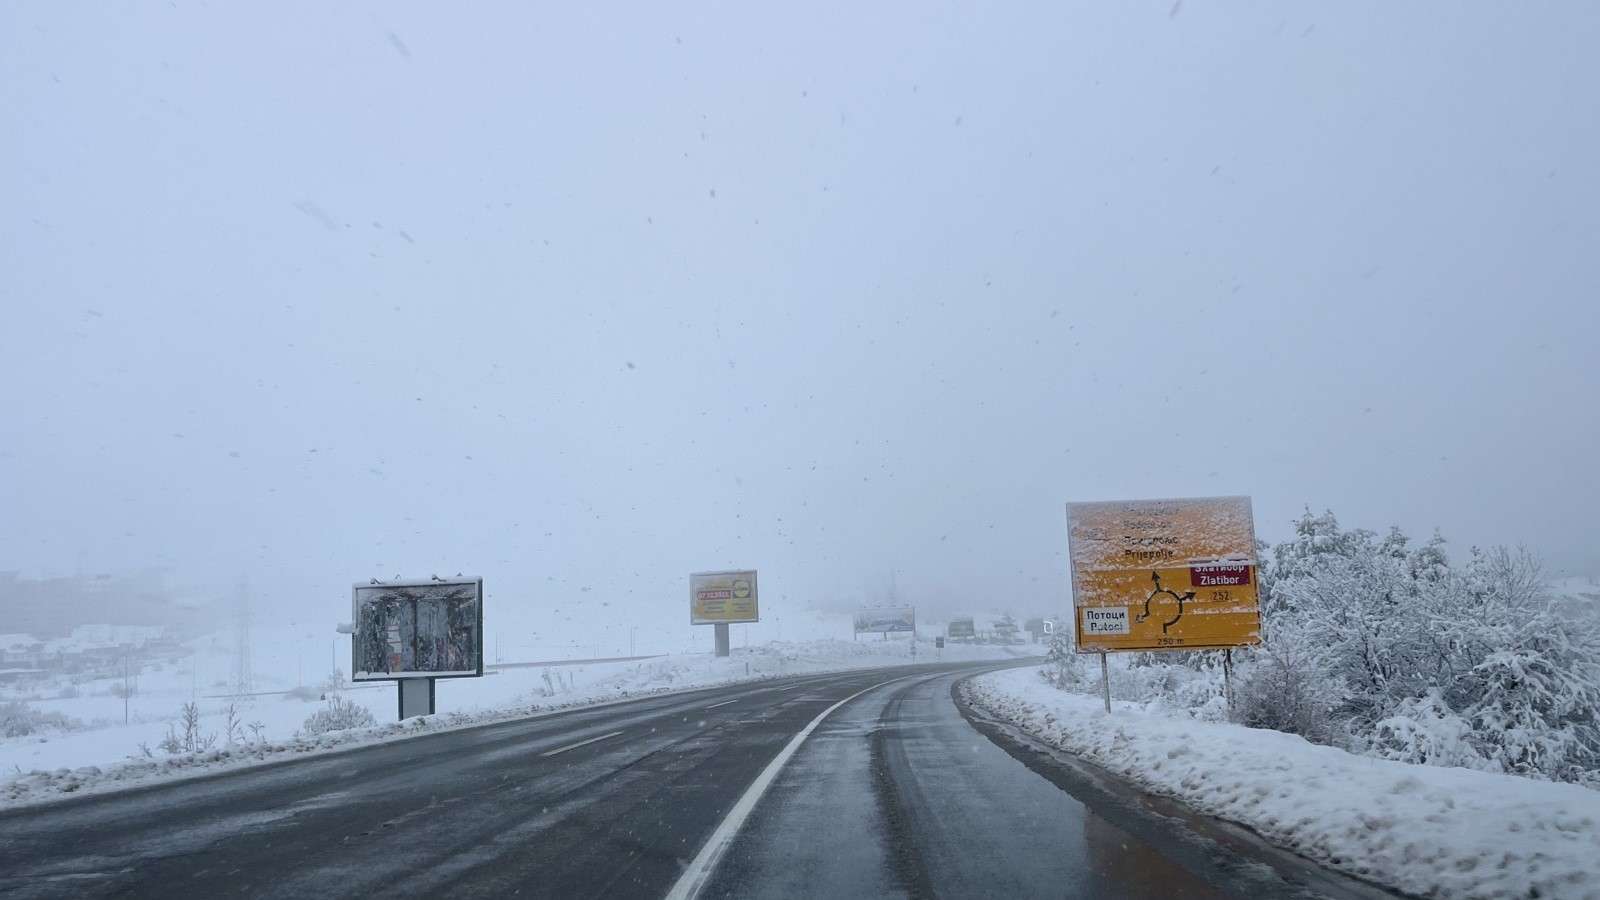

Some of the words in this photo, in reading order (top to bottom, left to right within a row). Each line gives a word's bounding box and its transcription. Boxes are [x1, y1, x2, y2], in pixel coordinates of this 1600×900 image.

[1125, 549, 1173, 560] Prijepolje
[1200, 575, 1239, 585] Zlatibor
[1087, 611, 1125, 620] Потоци
